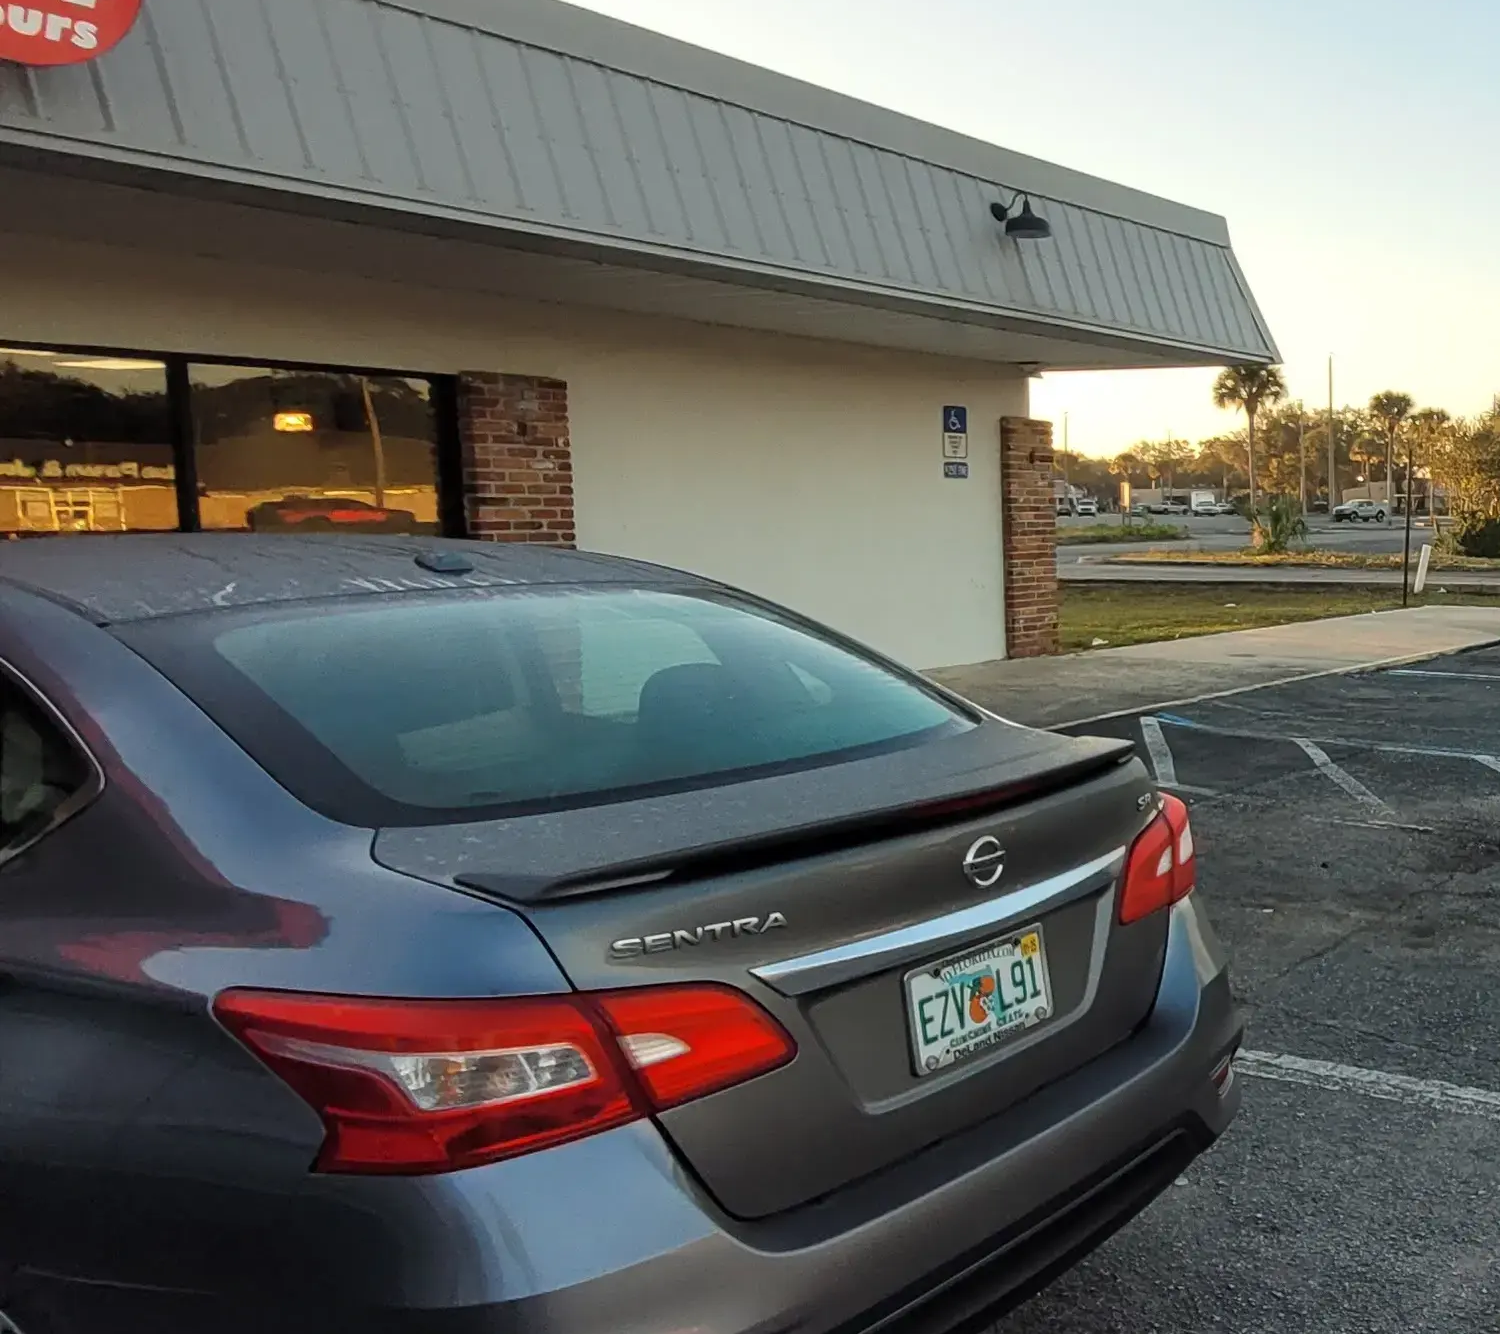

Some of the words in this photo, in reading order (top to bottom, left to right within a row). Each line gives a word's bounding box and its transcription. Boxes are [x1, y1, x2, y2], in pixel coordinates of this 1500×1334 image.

[0, 1, 98, 49] urs
[611, 911, 788, 958] SENTRA
[918, 981, 967, 1046] EZV
[995, 956, 1041, 1012] L91
